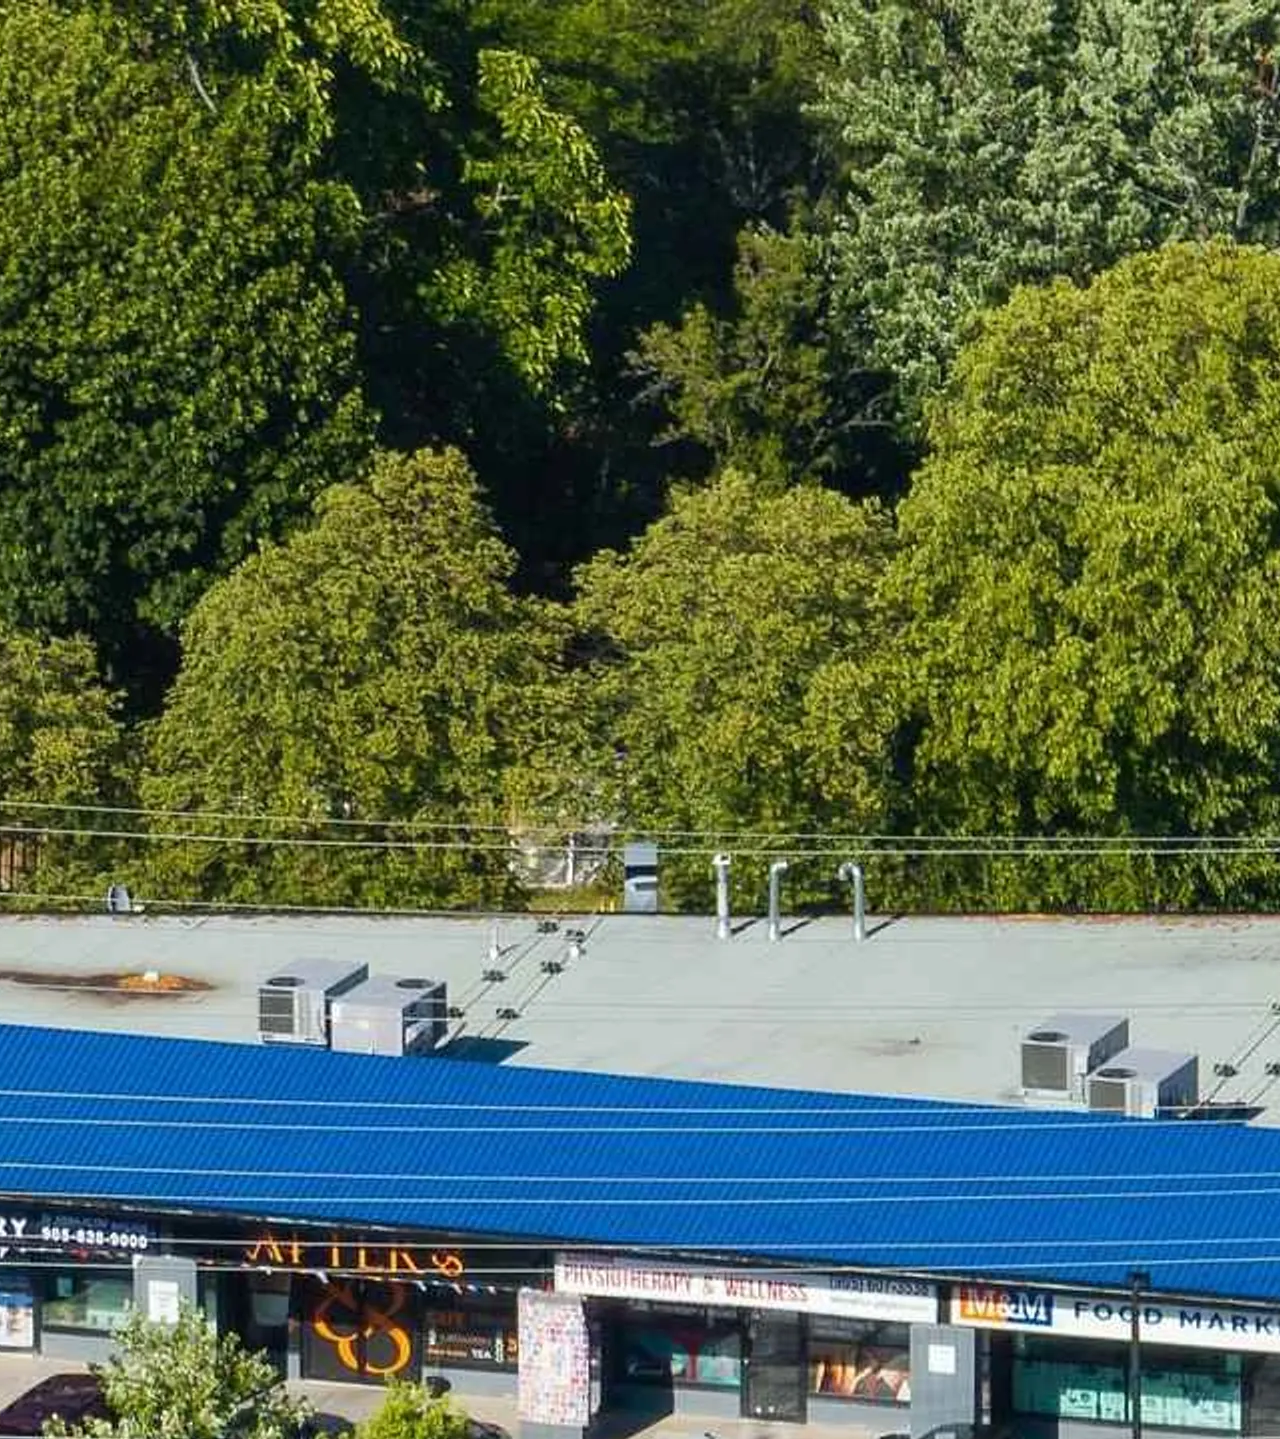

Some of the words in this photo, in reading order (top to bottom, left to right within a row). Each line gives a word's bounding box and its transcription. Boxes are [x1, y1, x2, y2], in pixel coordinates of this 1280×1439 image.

[563, 1262, 692, 1296] PHYSIOTHERAPY
[723, 1272, 809, 1302] WELLNESS
[967, 1287, 1048, 1321] M&M
[1073, 1301, 1163, 1325] FOOD
